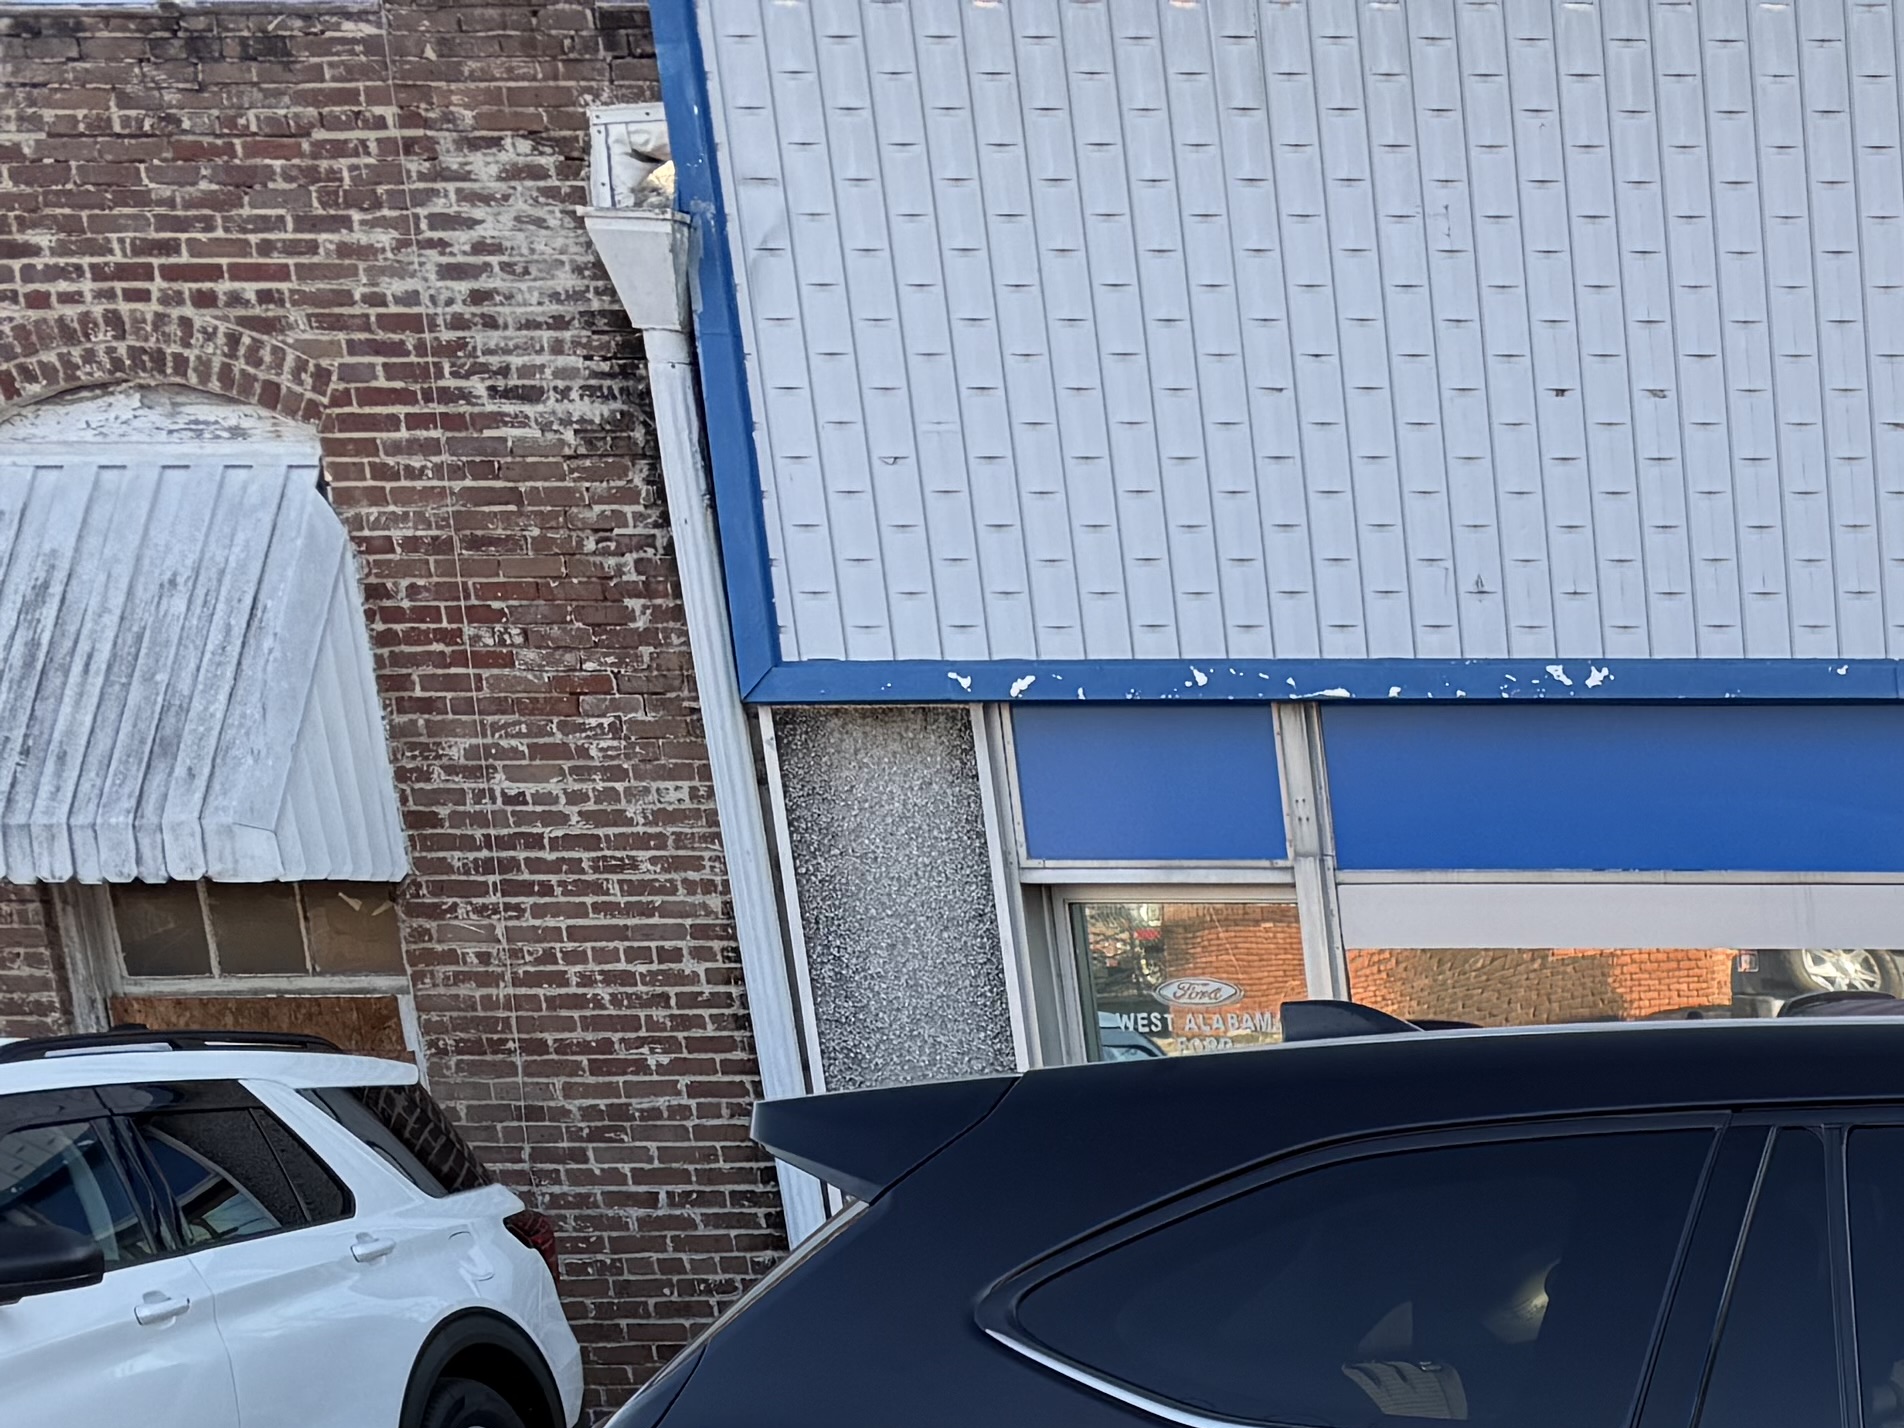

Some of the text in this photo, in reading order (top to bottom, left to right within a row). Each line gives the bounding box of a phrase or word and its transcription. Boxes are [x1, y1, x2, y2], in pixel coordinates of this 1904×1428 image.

[1173, 981, 1224, 1001] Ford
[1115, 1011, 1175, 1033] WEST
[1177, 1036, 1233, 1054] FORD
